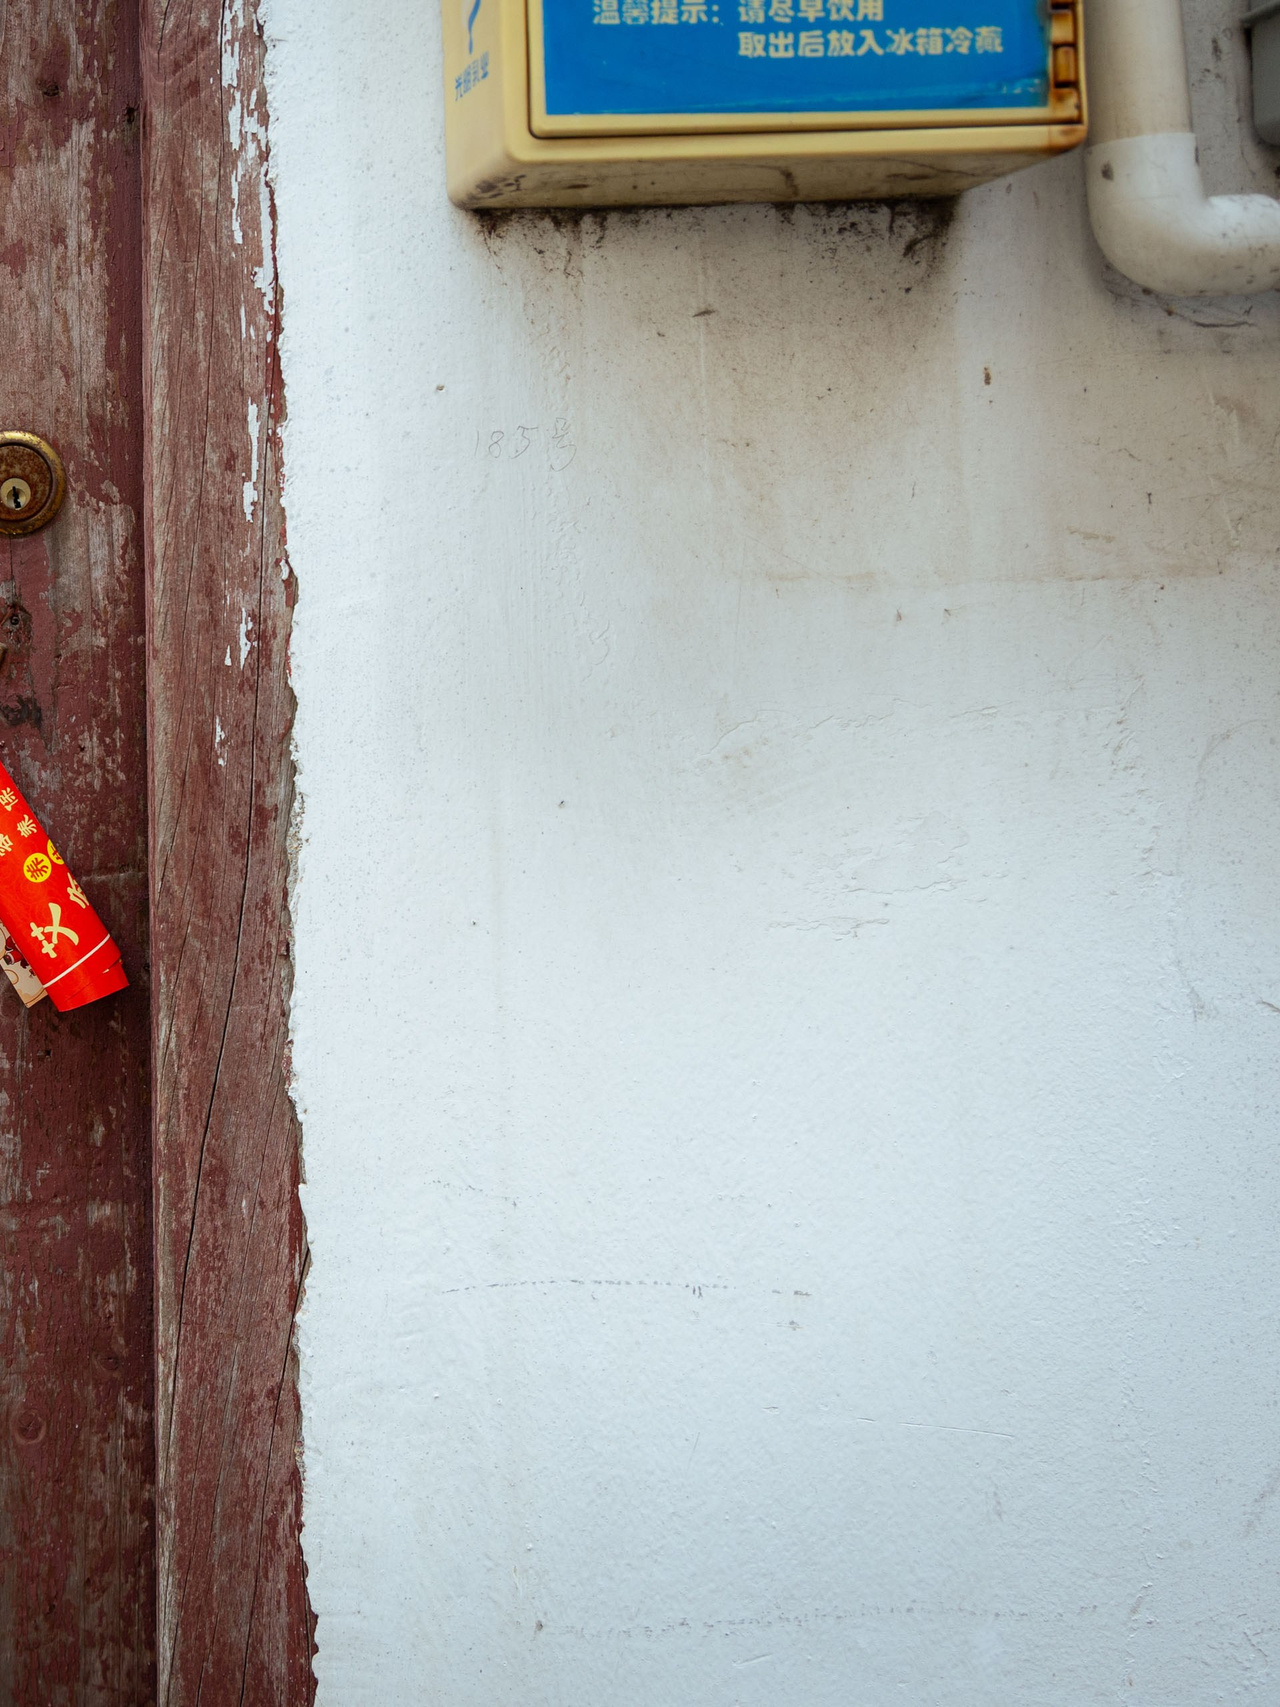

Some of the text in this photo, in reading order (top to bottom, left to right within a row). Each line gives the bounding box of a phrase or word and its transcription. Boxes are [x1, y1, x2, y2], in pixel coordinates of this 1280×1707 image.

[738, 0, 884, 24] 请尽早饮用
[738, 26, 1004, 58] 取出后放入冰箱冷藏
